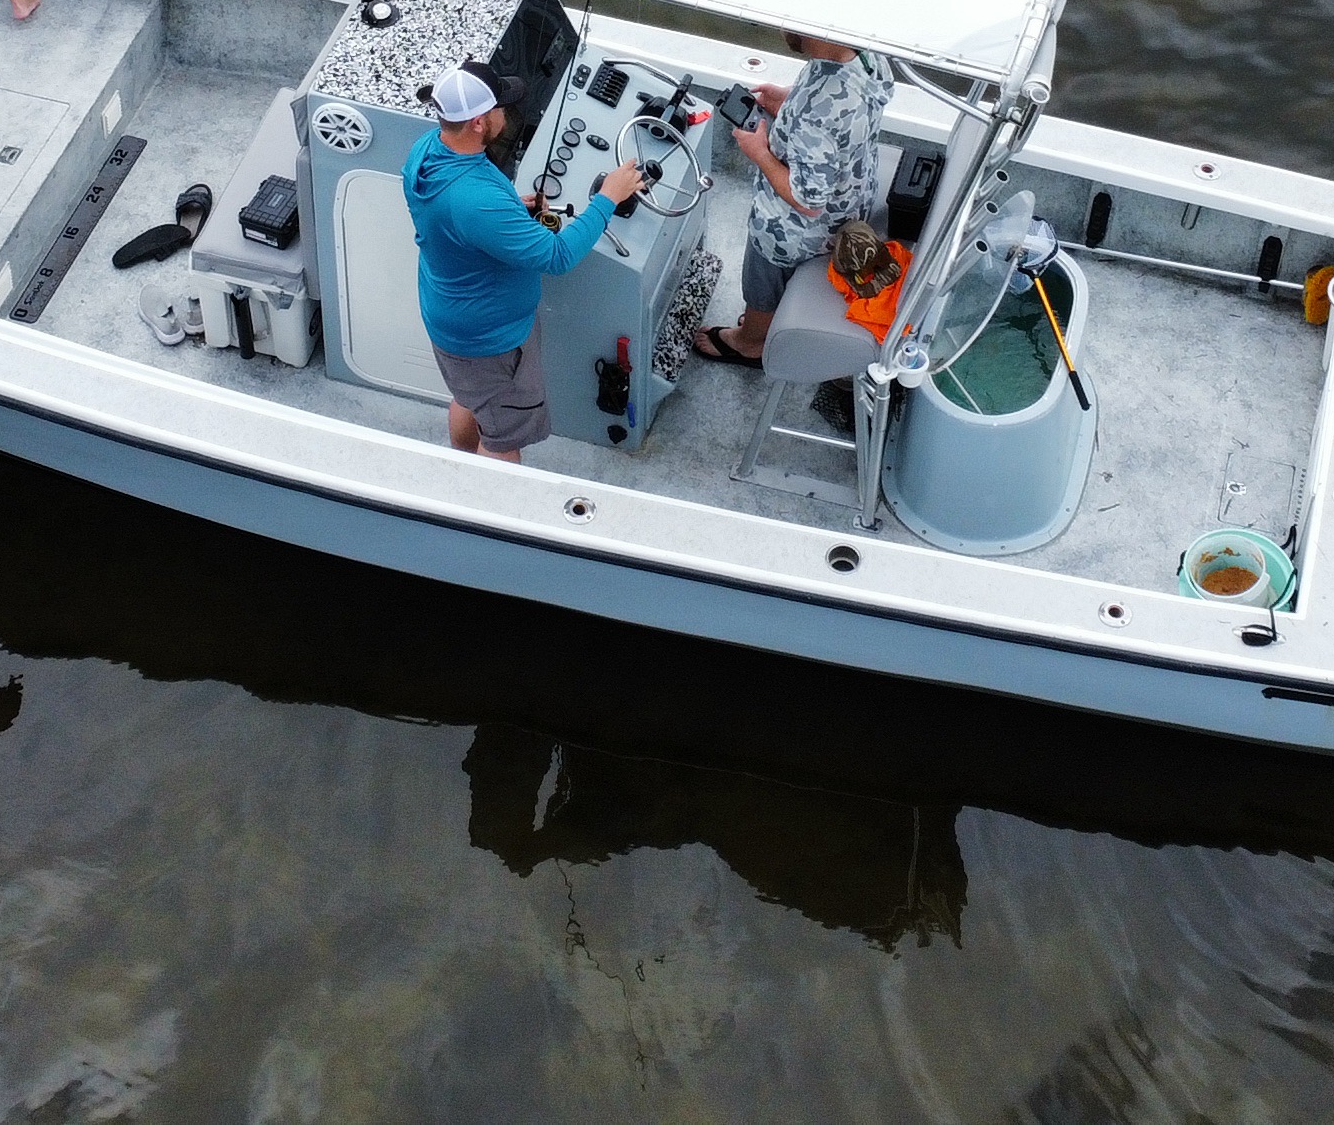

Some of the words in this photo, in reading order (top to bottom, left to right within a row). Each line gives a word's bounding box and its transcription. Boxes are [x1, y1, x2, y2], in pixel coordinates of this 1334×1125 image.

[39, 266, 54, 278] 8
[62, 226, 80, 240] 16
[85, 185, 105, 204] 24
[109, 148, 129, 167] 32
